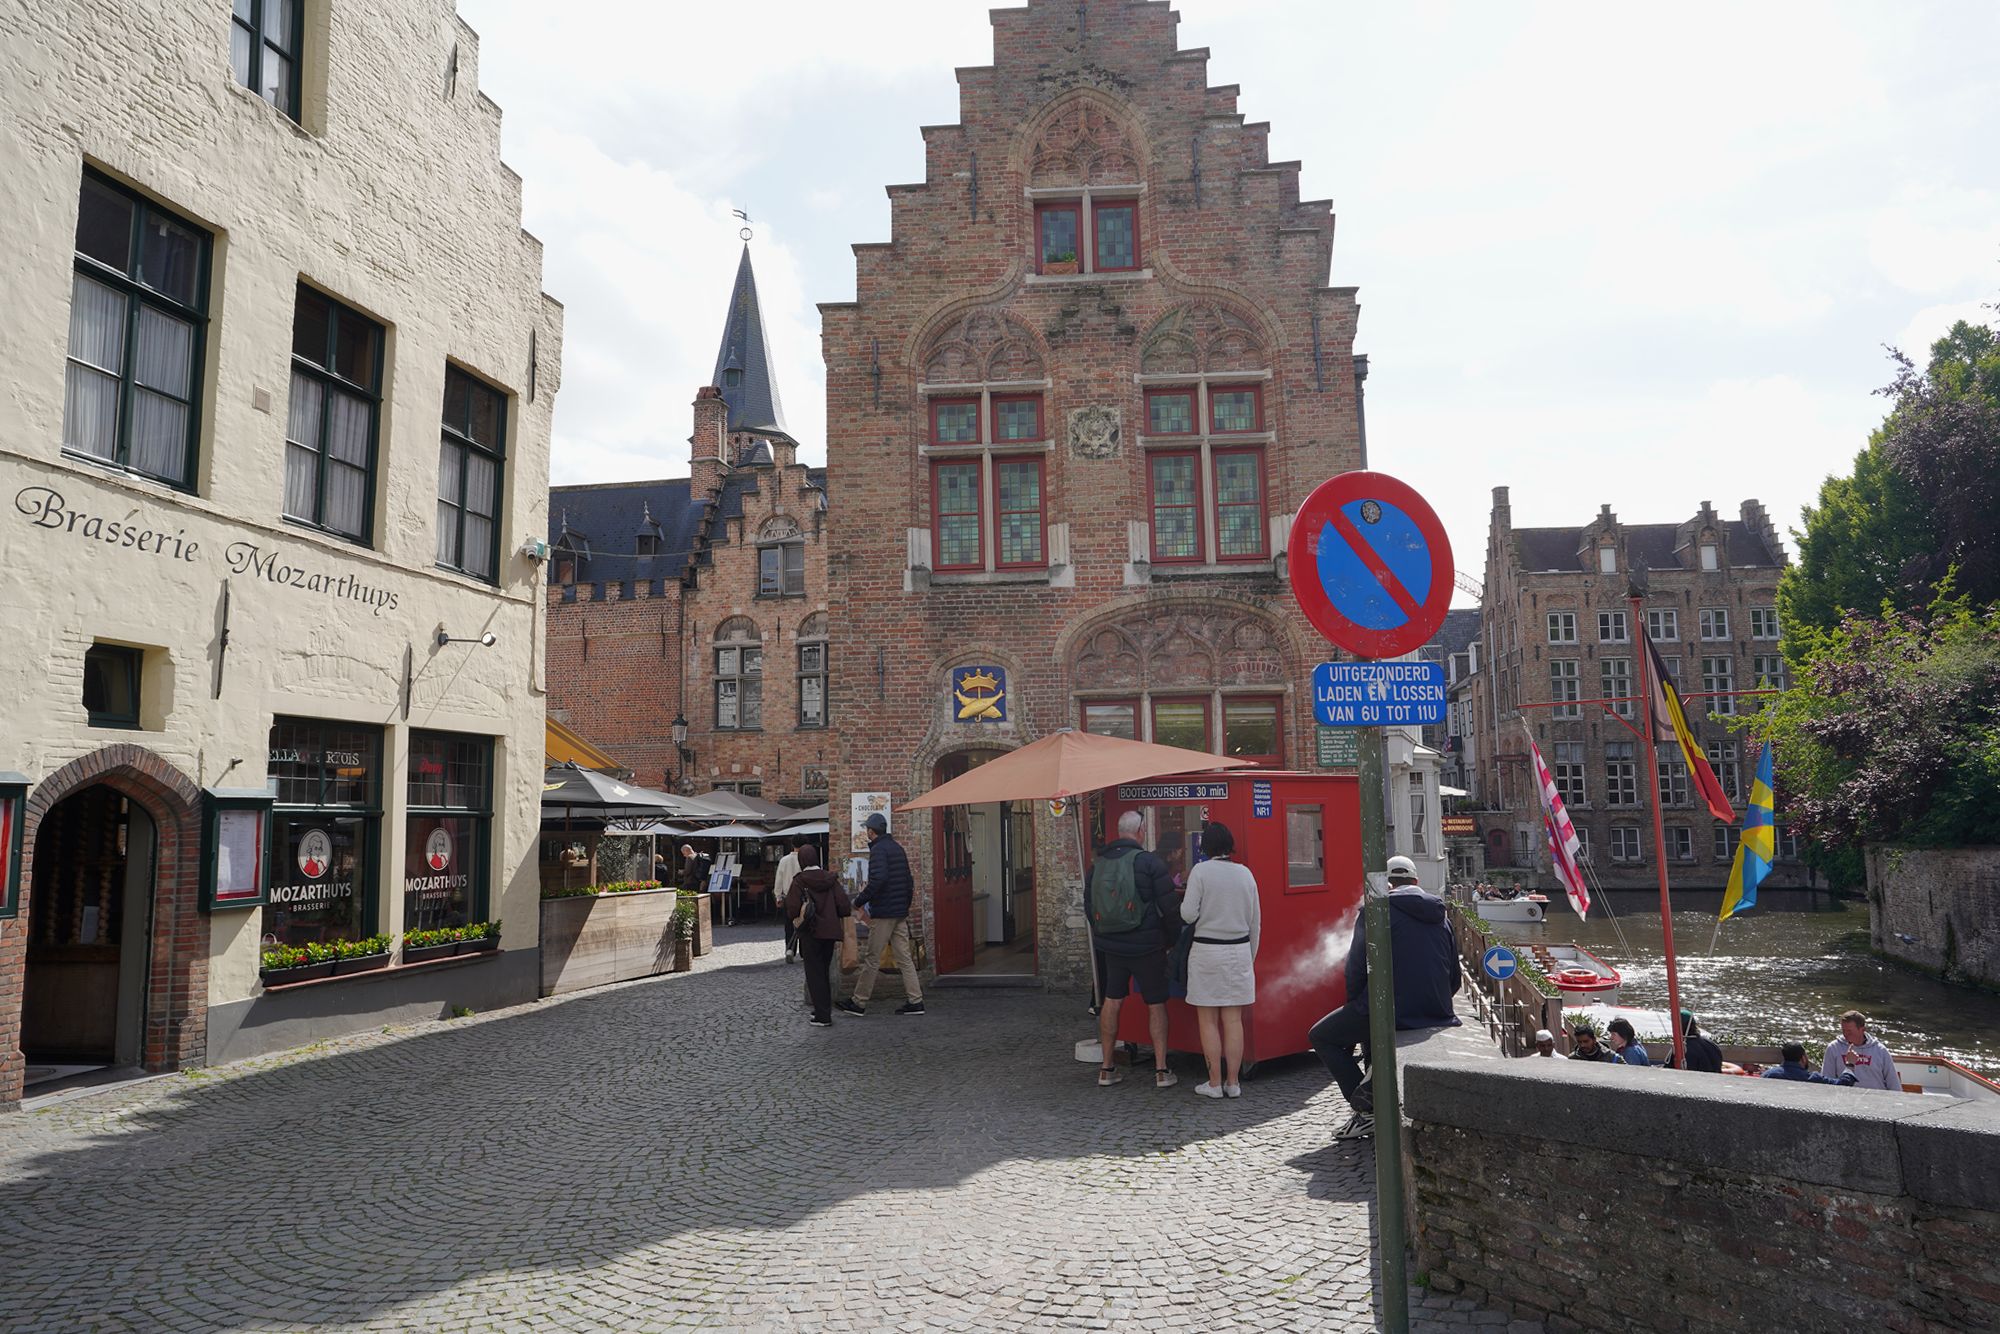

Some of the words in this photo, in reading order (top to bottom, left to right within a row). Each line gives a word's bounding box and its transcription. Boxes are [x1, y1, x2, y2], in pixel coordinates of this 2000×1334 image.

[15, 486, 199, 563] Brasserie
[225, 541, 399, 616] Mozarthuys
[1329, 666, 1430, 682] UITGEZONDERD
[1318, 686, 1362, 701] LADEN
[1368, 684, 1387, 701] EN
[1393, 684, 1443, 701] LOSSEN
[1327, 706, 1354, 721] VAN
[1361, 706, 1379, 721] 6U
[1386, 705, 1411, 720] TOT
[1417, 705, 1437, 720] 11U
[1120, 786, 1189, 798] BOOTEXCURSIES
[1196, 786, 1206, 797] 30
[1209, 784, 1227, 797] min.
[1256, 806, 1270, 816] NR1
[405, 874, 467, 892] MOZARTHUYS
[270, 882, 352, 903] MOZARTHUYS
[292, 901, 332, 912] BRASSERIE
